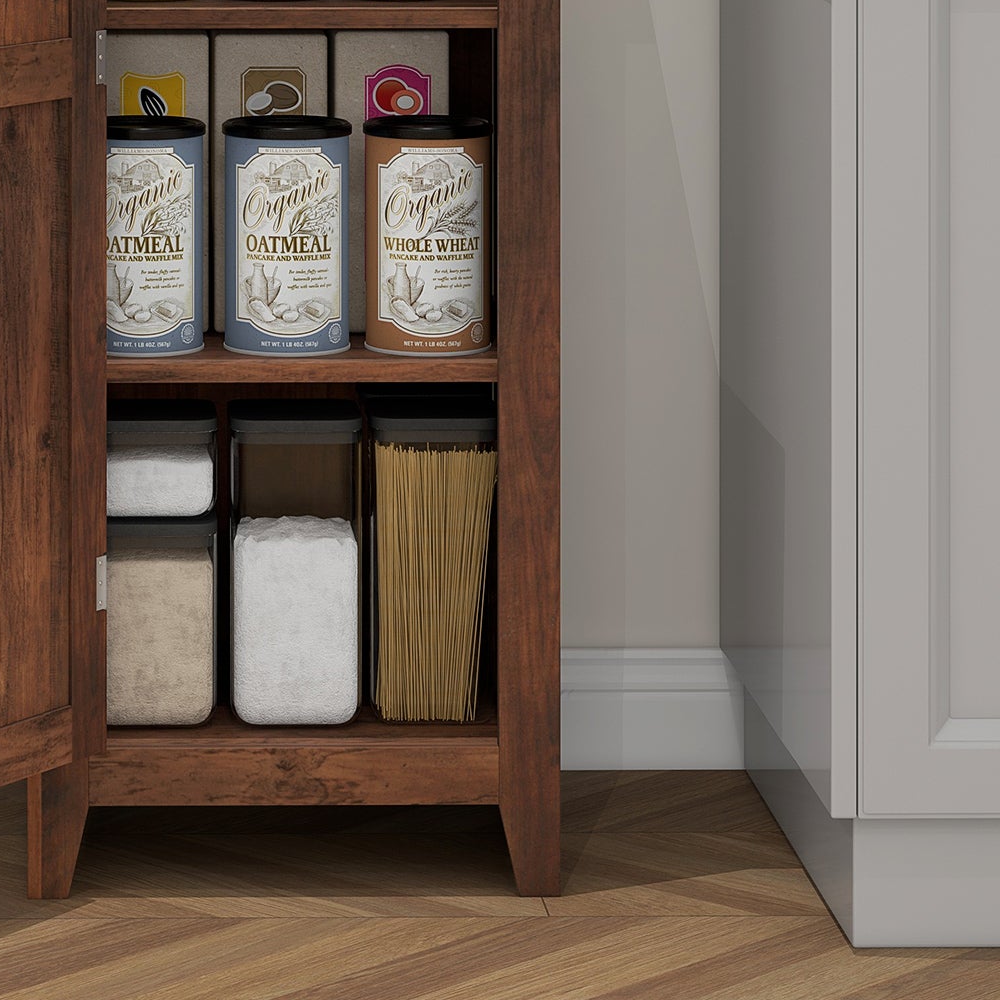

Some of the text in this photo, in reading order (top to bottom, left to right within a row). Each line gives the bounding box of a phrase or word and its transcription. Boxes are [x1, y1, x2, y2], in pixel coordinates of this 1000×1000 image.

[243, 168, 330, 233] Organic
[385, 168, 473, 233] Organic
[106, 234, 184, 254] ATMEAL
[246, 233, 331, 254] OATMEAL
[384, 236, 480, 252] WHOLE WHEAT
[246, 253, 275, 261] PANCAKE
[389, 253, 418, 261] PANCAKE
[462, 252, 474, 260] MIX
